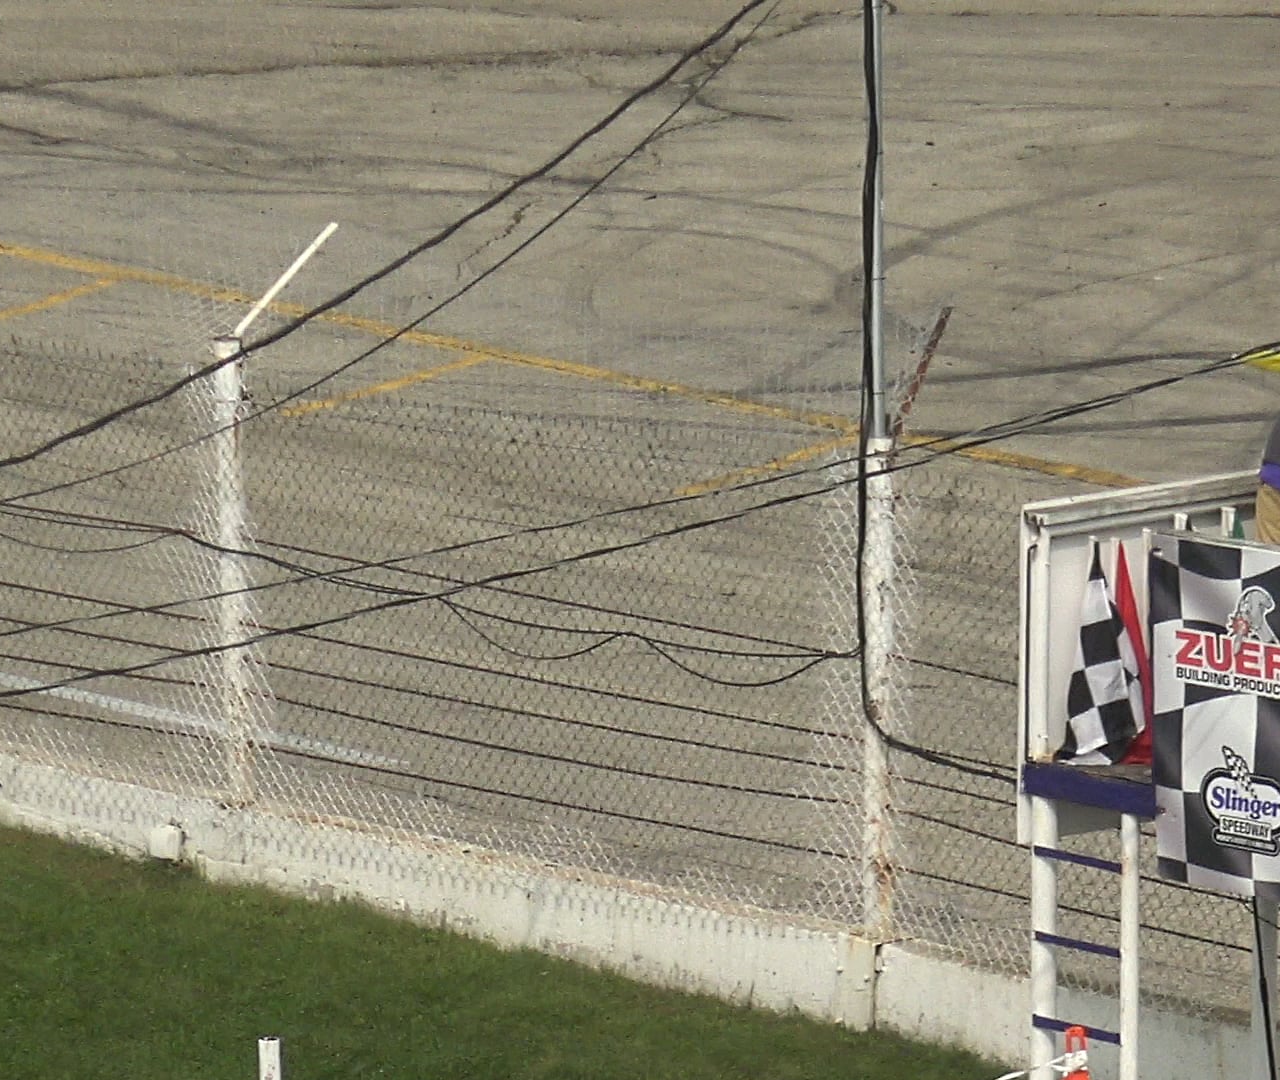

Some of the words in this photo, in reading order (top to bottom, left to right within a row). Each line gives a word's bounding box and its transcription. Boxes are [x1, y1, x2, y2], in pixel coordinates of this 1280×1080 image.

[1176, 667, 1231, 687] BUILDING
[1210, 785, 1280, 820] Slinger
[1221, 818, 1270, 839] SPEEDWAY
